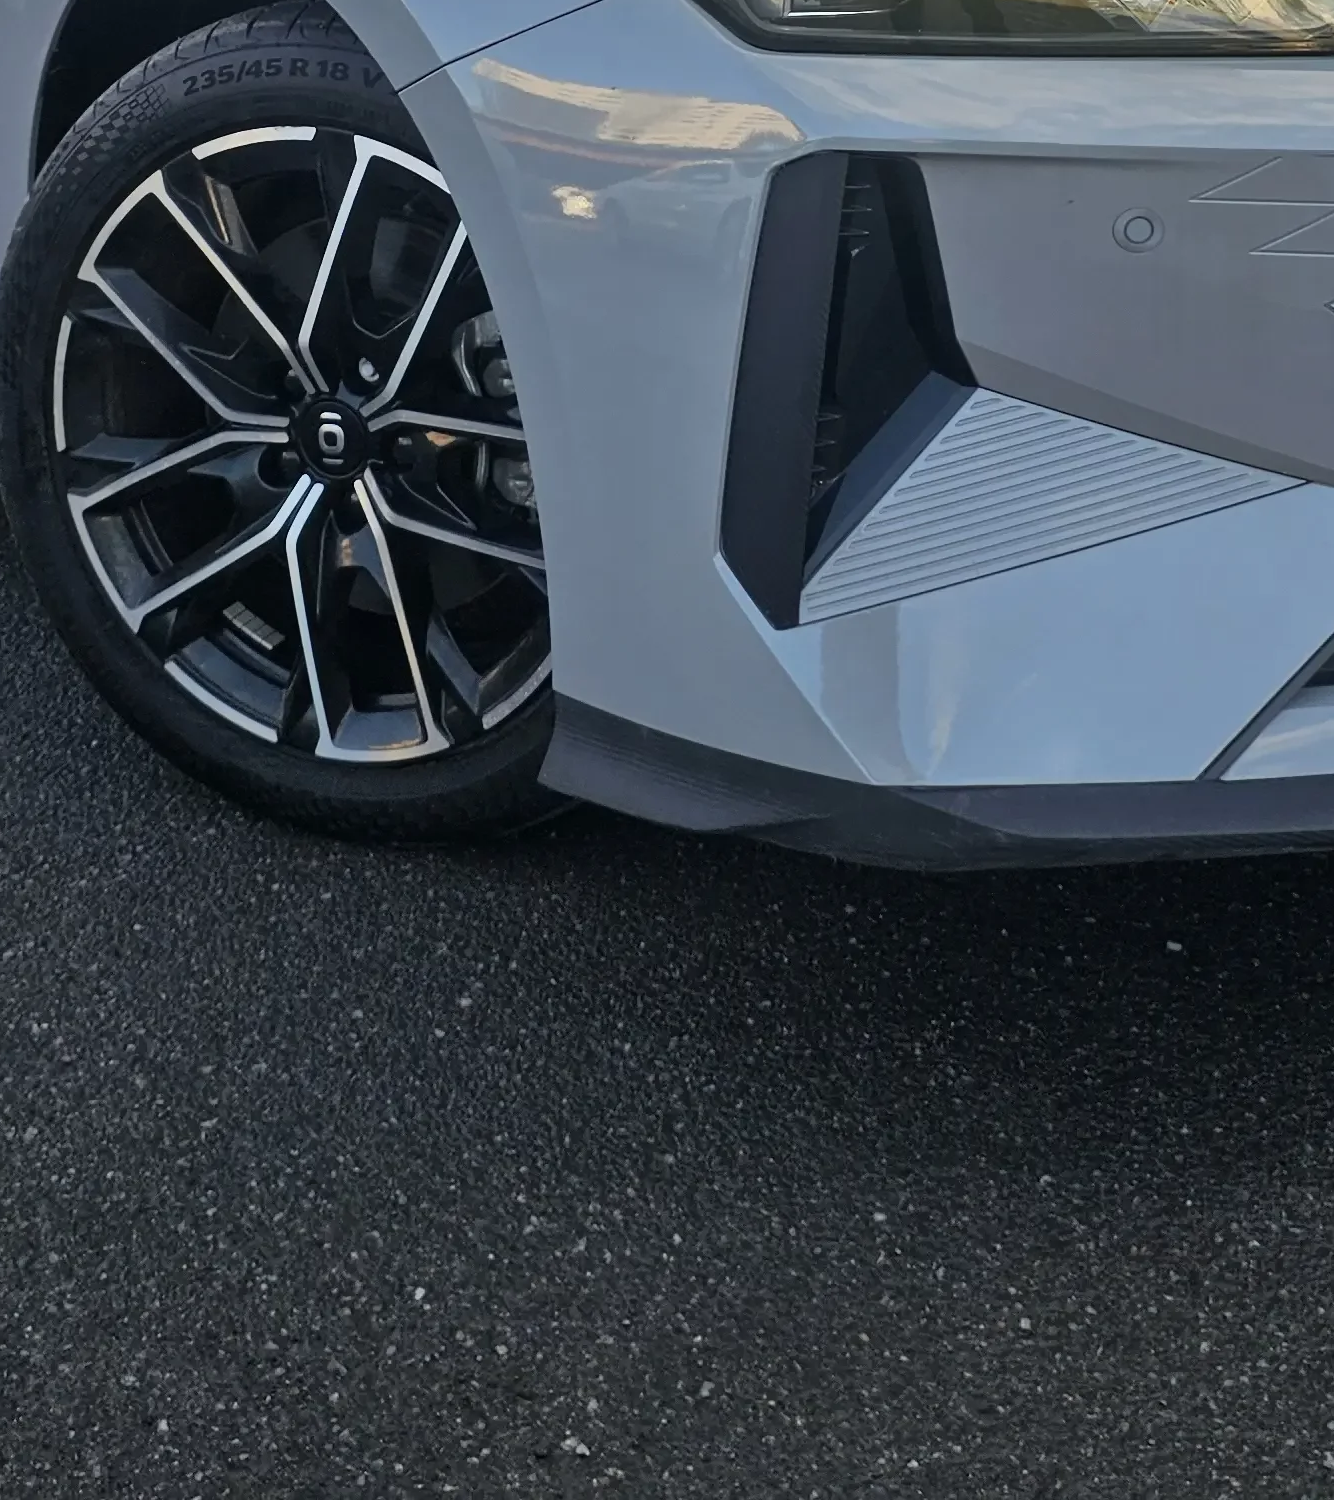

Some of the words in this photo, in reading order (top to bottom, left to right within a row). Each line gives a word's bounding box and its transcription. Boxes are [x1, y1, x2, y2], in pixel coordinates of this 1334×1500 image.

[182, 57, 282, 96] 235/45
[288, 57, 310, 78] R
[317, 59, 350, 81] 18
